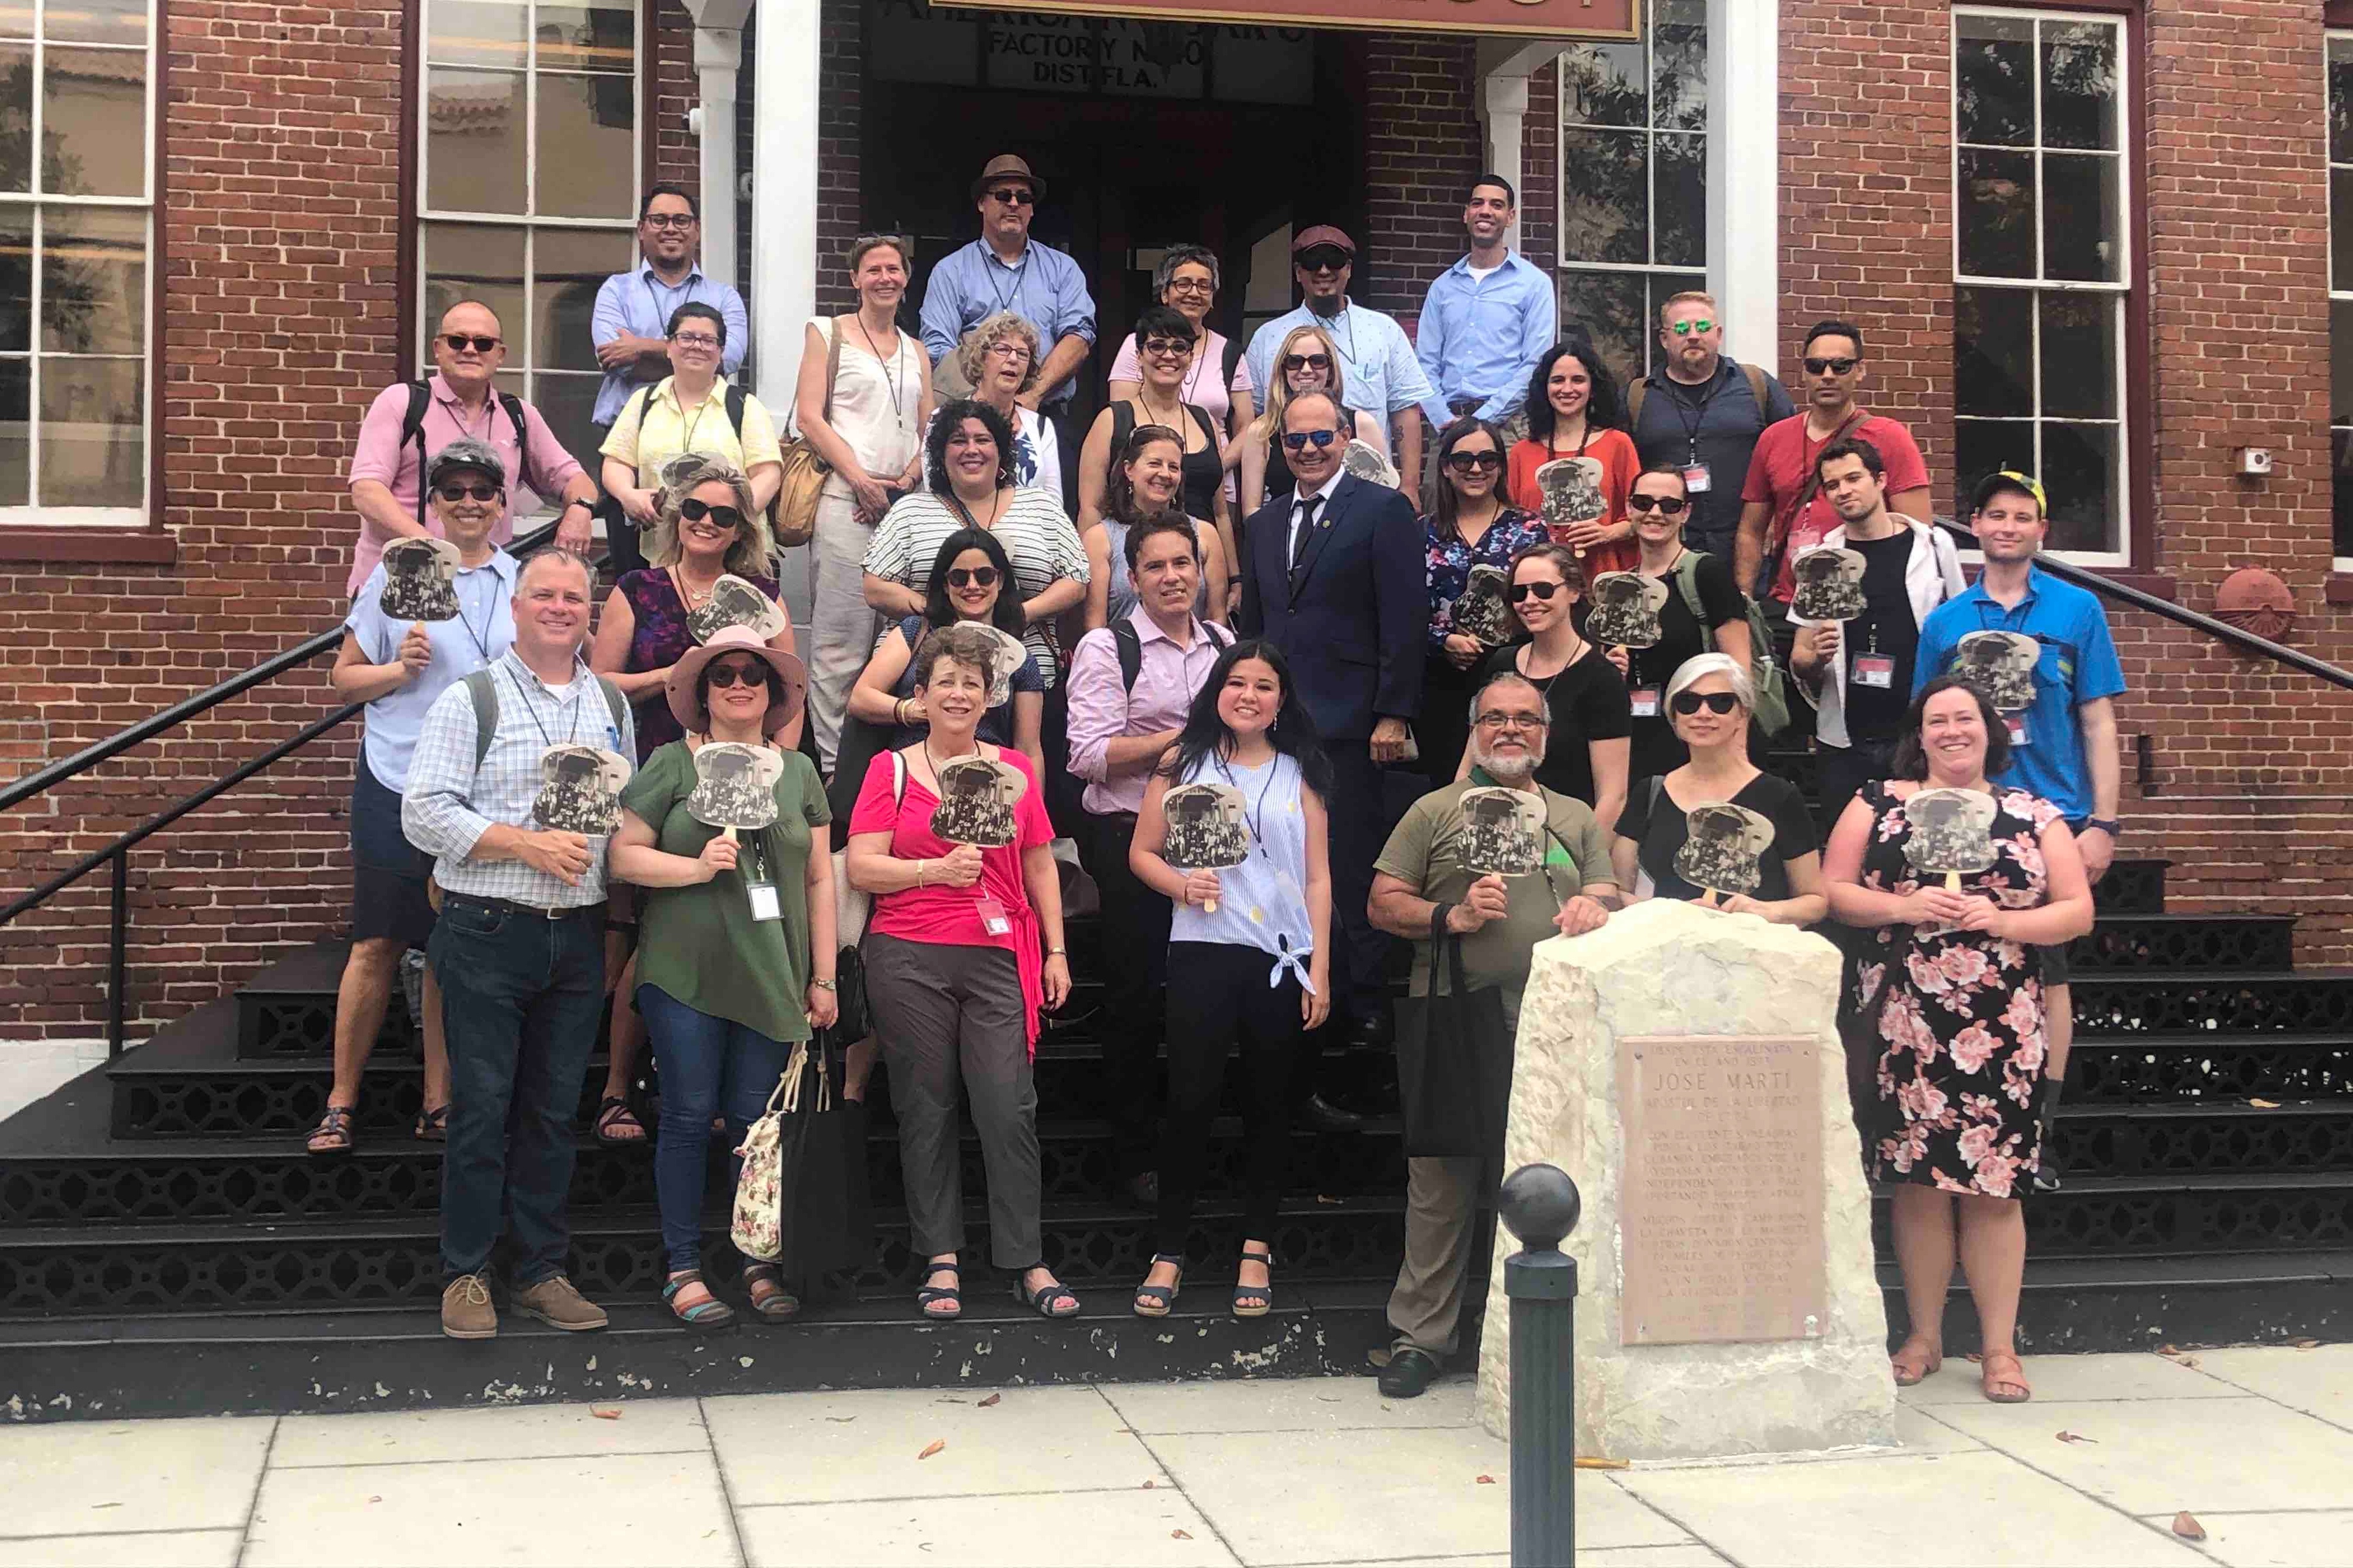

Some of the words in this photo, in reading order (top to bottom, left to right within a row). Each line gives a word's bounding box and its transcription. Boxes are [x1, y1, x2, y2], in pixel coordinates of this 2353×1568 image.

[988, 31, 1117, 61] FACTORY
[1100, 66, 1158, 89] FLA.
[1653, 1072, 1707, 1091] JOSE
